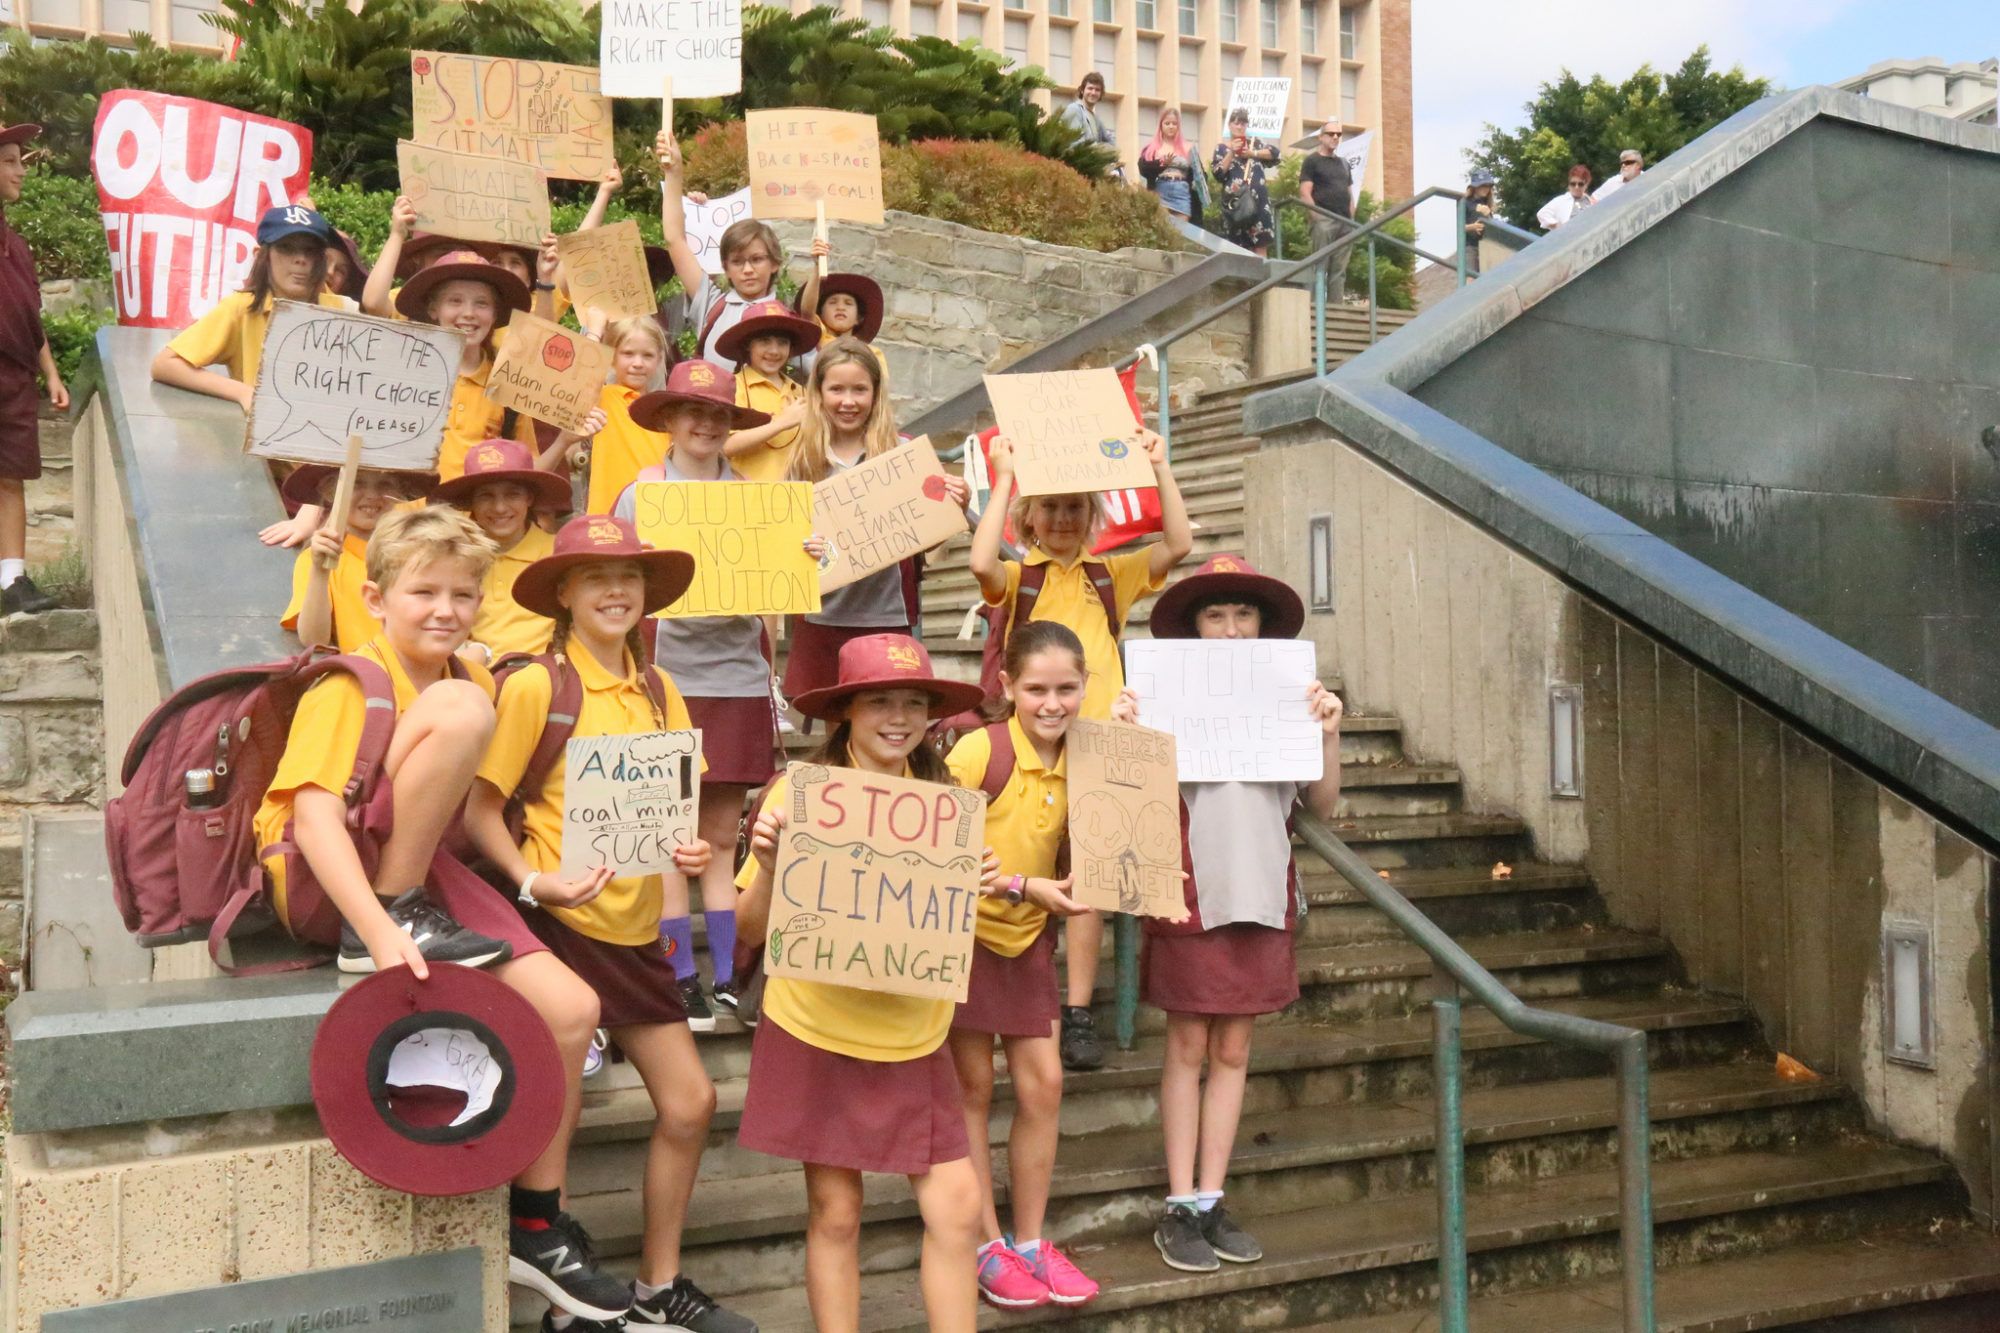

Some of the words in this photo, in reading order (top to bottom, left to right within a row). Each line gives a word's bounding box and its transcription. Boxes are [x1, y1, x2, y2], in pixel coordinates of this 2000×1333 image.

[613, 1, 681, 30] MAKE
[690, 0, 739, 29] THE
[609, 35, 668, 65] RIGHT
[675, 36, 742, 60] CHOICE
[431, 55, 545, 128] STOP
[1235, 80, 1289, 91] POLITICIANS
[1236, 93, 1259, 104] NEED
[1262, 93, 1276, 103] TO
[768, 121, 818, 140] HIT
[95, 99, 301, 223] OUR
[427, 160, 531, 200] CLIMATE
[827, 183, 875, 201] COAL!
[686, 200, 746, 228] TOP
[102, 212, 259, 318] FUTUR
[303, 319, 383, 365] MAKE
[400, 333, 434, 369] THE
[294, 361, 372, 396] RIGHT
[374, 382, 442, 408] CHOICE
[492, 359, 543, 392] Adani
[549, 382, 582, 407] Coal
[1016, 372, 1091, 396] SAVE
[345, 407, 426, 437] (PLEASE)
[512, 392, 551, 417] Mine
[1028, 394, 1081, 413] OUR
[1011, 413, 1105, 442] PLANET
[640, 482, 812, 528] SOLUTION
[853, 503, 867, 520] 4
[836, 497, 925, 551] CLIMATE
[698, 526, 768, 569] NOT
[847, 526, 921, 575] ACTION
[1132, 643, 1273, 700] STOP
[576, 749, 674, 783] Adani
[1103, 755, 1148, 787] NO
[1178, 749, 1274, 777] ANGE
[569, 796, 622, 824] coal
[636, 803, 694, 821] mine
[817, 781, 958, 849] STOP
[781, 856, 977, 934] CLIMATE
[1083, 858, 1184, 900] PLANET
[787, 936, 967, 988] CHANGE!
[286, 1303, 370, 1333] MEMORIAL
[378, 1291, 458, 1321] FOUNTAIN
